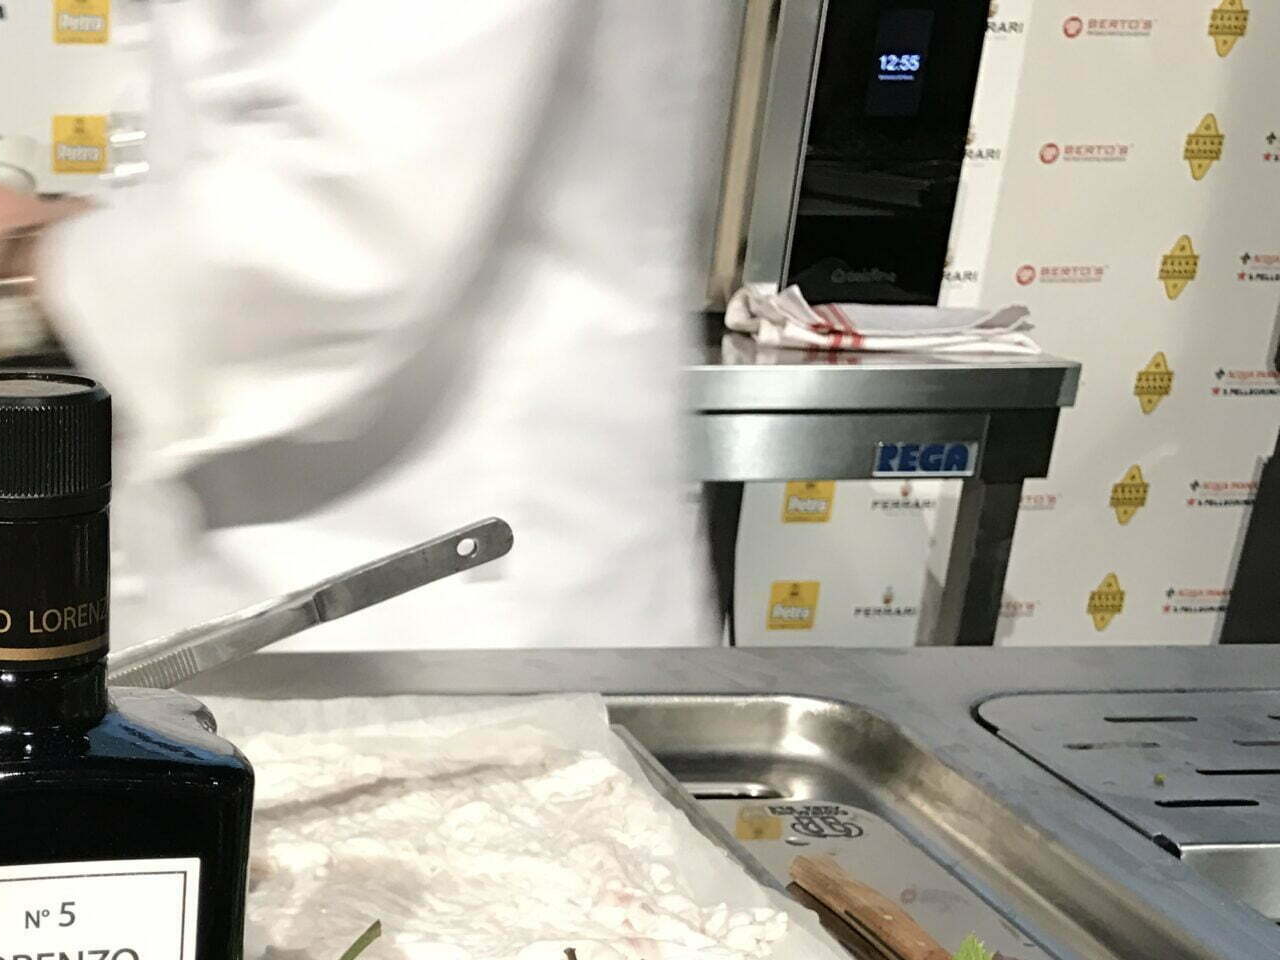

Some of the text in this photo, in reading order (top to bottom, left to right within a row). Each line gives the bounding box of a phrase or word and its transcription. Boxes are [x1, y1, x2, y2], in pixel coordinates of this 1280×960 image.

[879, 54, 920, 71] 12:55
[877, 443, 969, 472] REGA
[58, 901, 76, 928] 5
